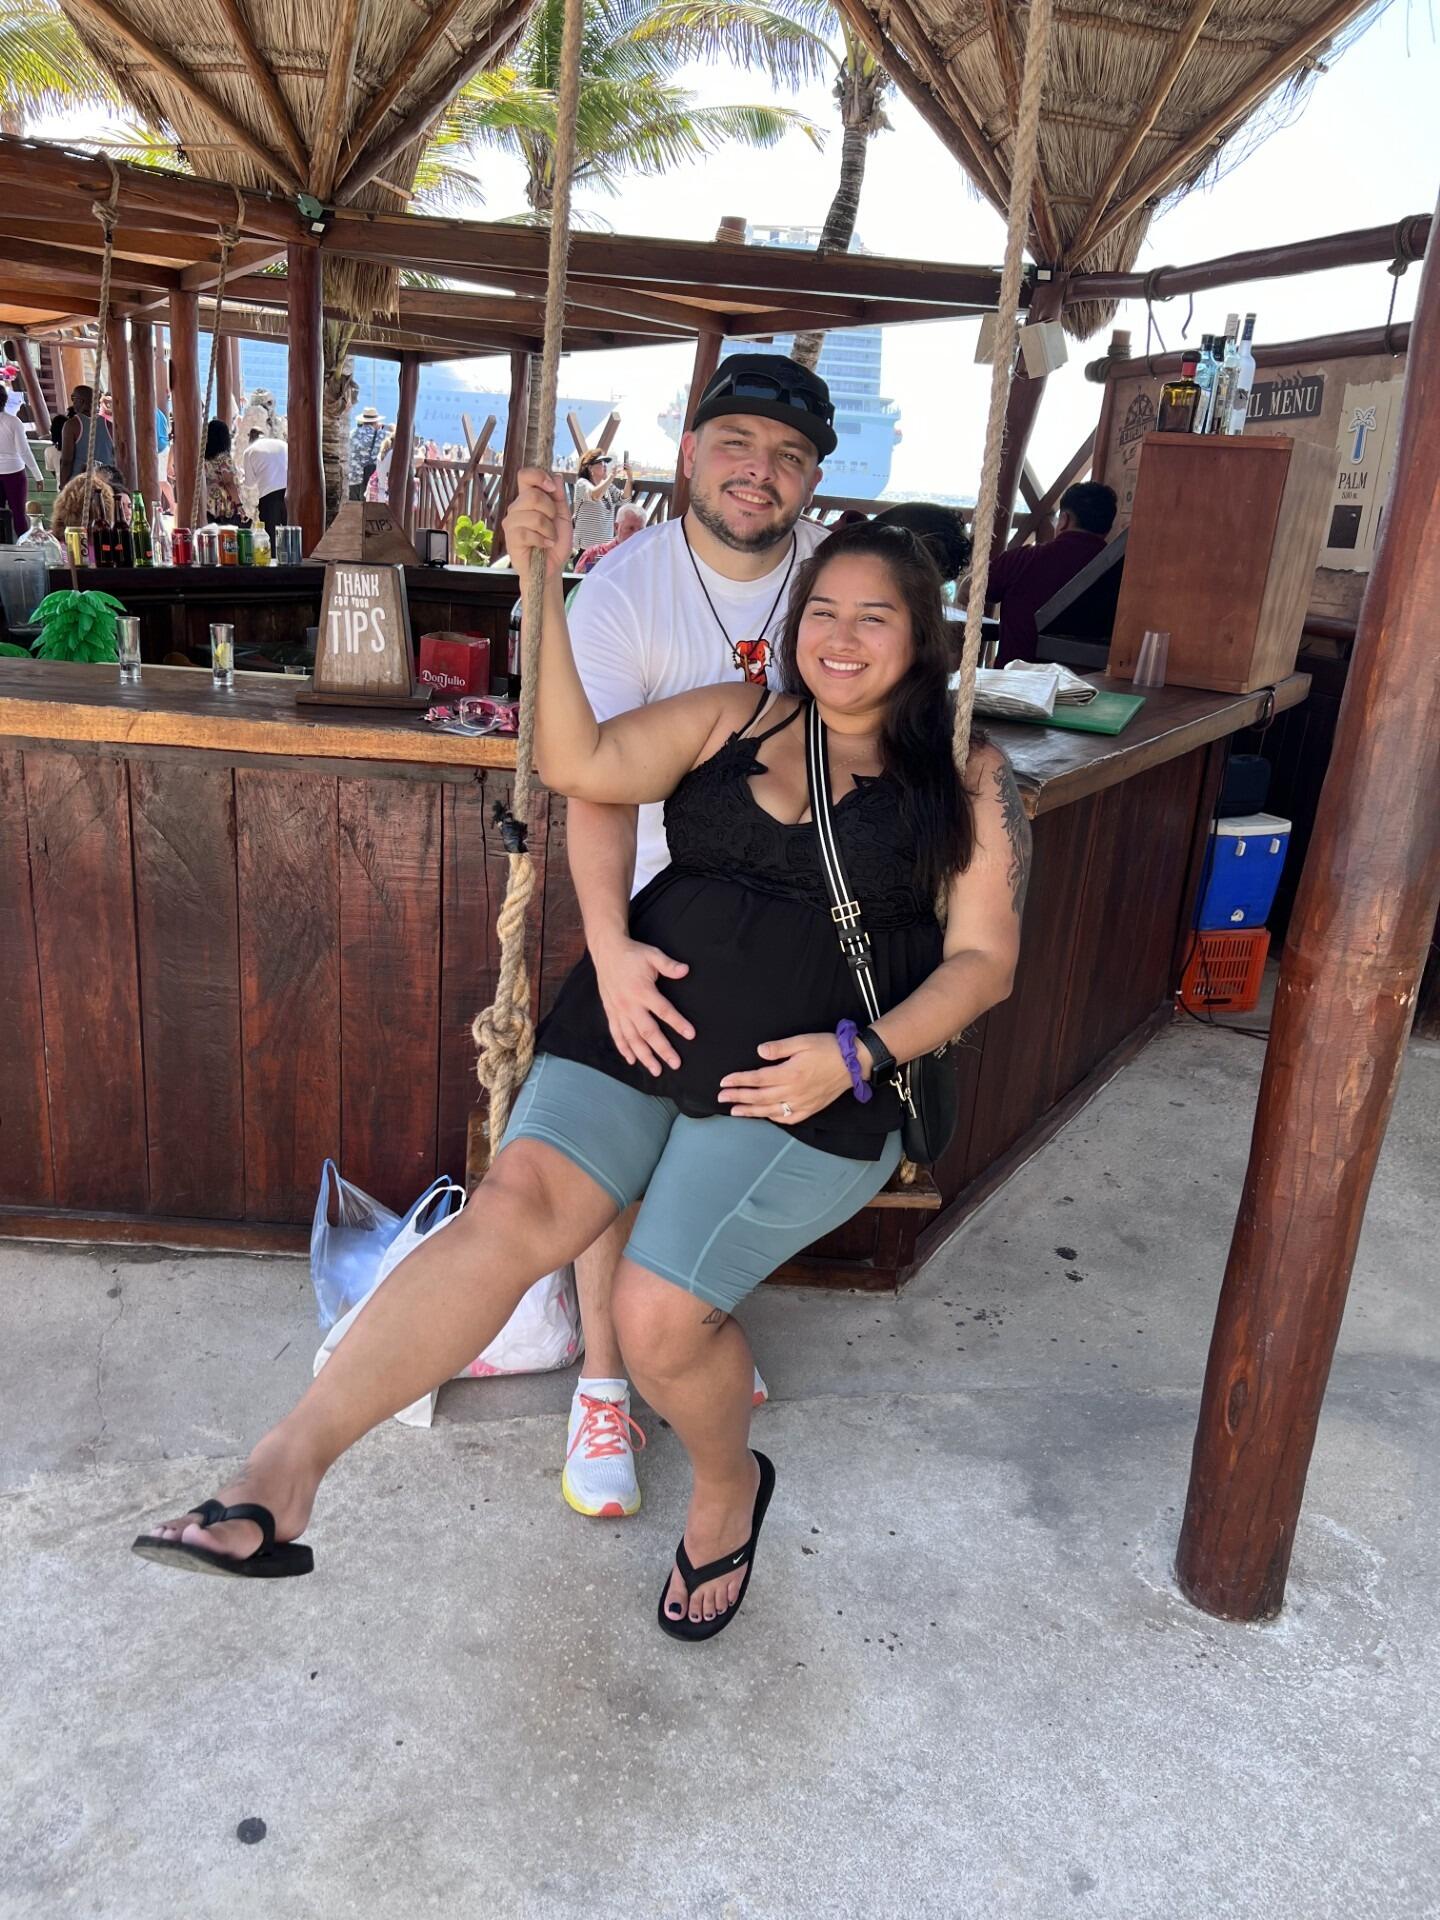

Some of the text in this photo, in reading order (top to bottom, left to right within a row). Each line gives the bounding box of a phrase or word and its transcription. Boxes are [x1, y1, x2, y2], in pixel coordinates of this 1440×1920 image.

[1269, 386, 1319, 416] MENU
[1338, 471, 1368, 489] PALM
[366, 519, 393, 531] TIPS
[335, 571, 379, 597] THANK
[334, 595, 349, 607] FOR
[328, 607, 386, 655] TIPS
